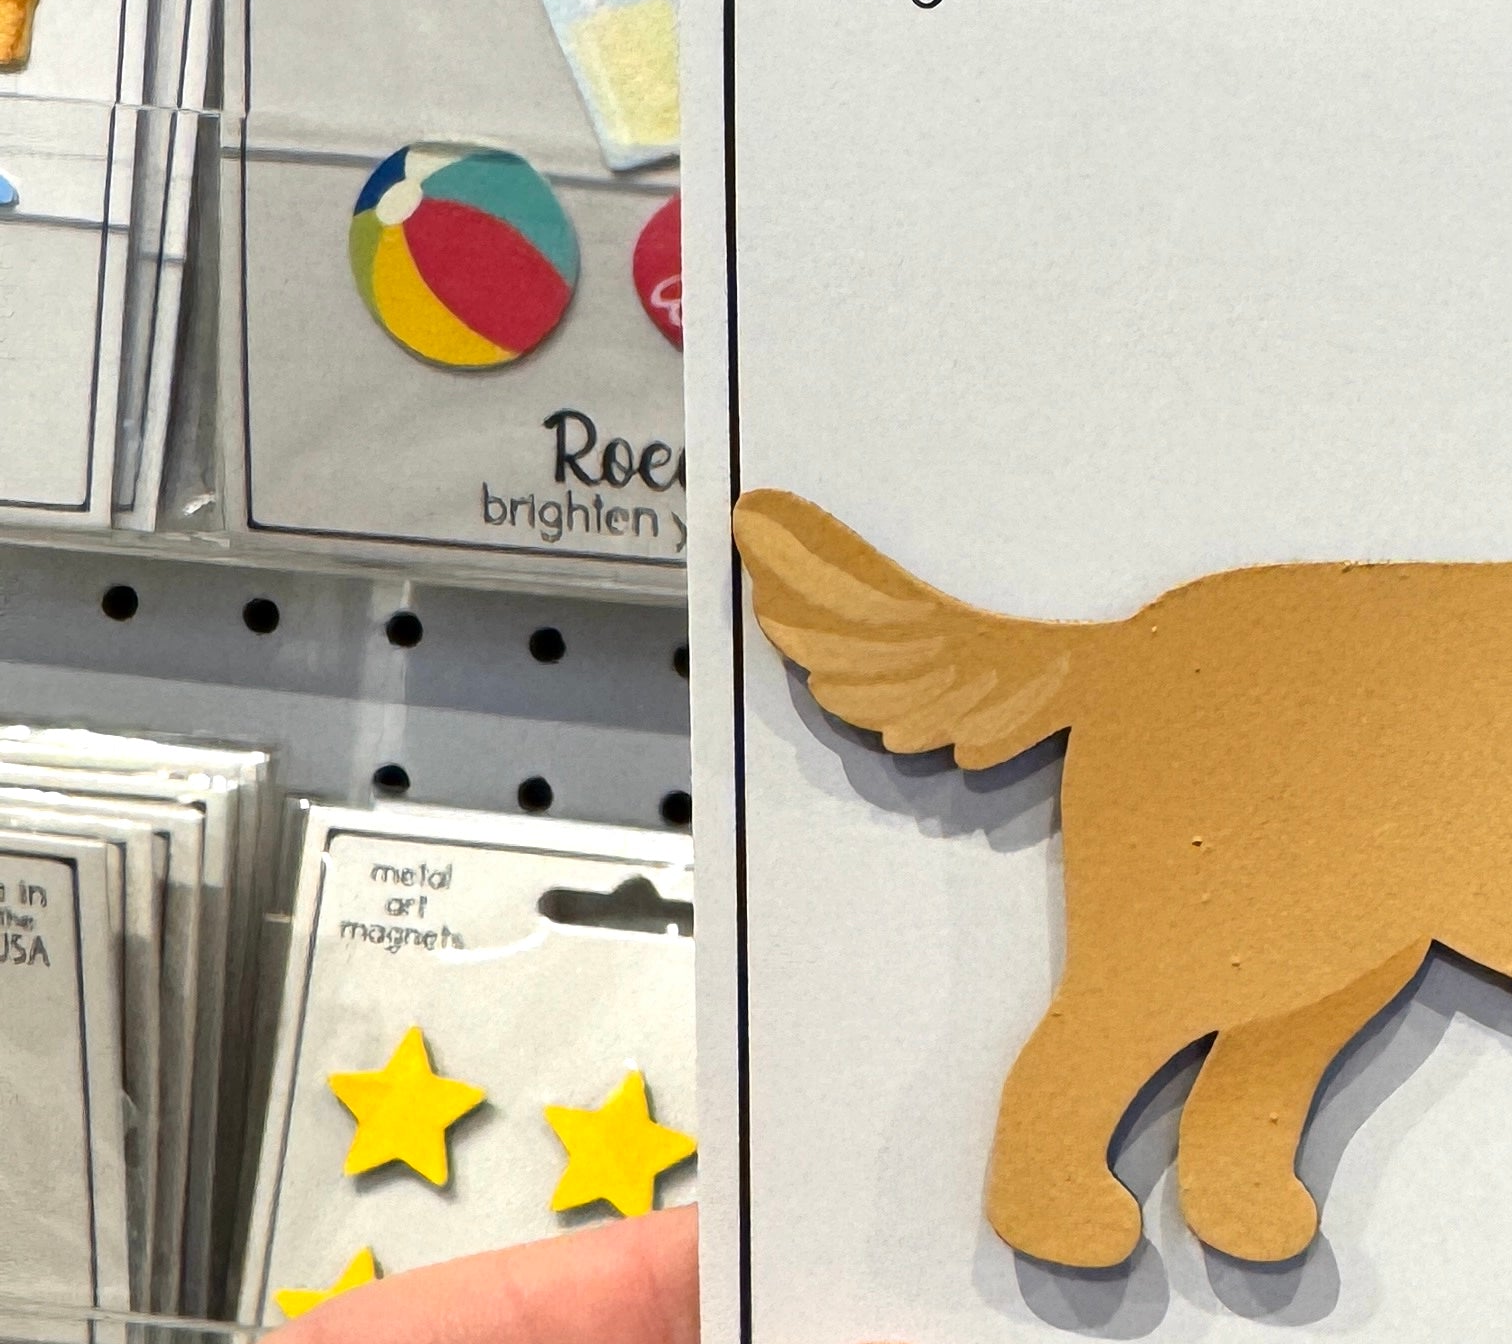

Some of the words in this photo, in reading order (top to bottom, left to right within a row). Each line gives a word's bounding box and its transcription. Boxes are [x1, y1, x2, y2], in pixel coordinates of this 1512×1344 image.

[541, 408, 687, 493] Roe
[481, 480, 660, 544] brighten
[370, 863, 453, 890] metal
